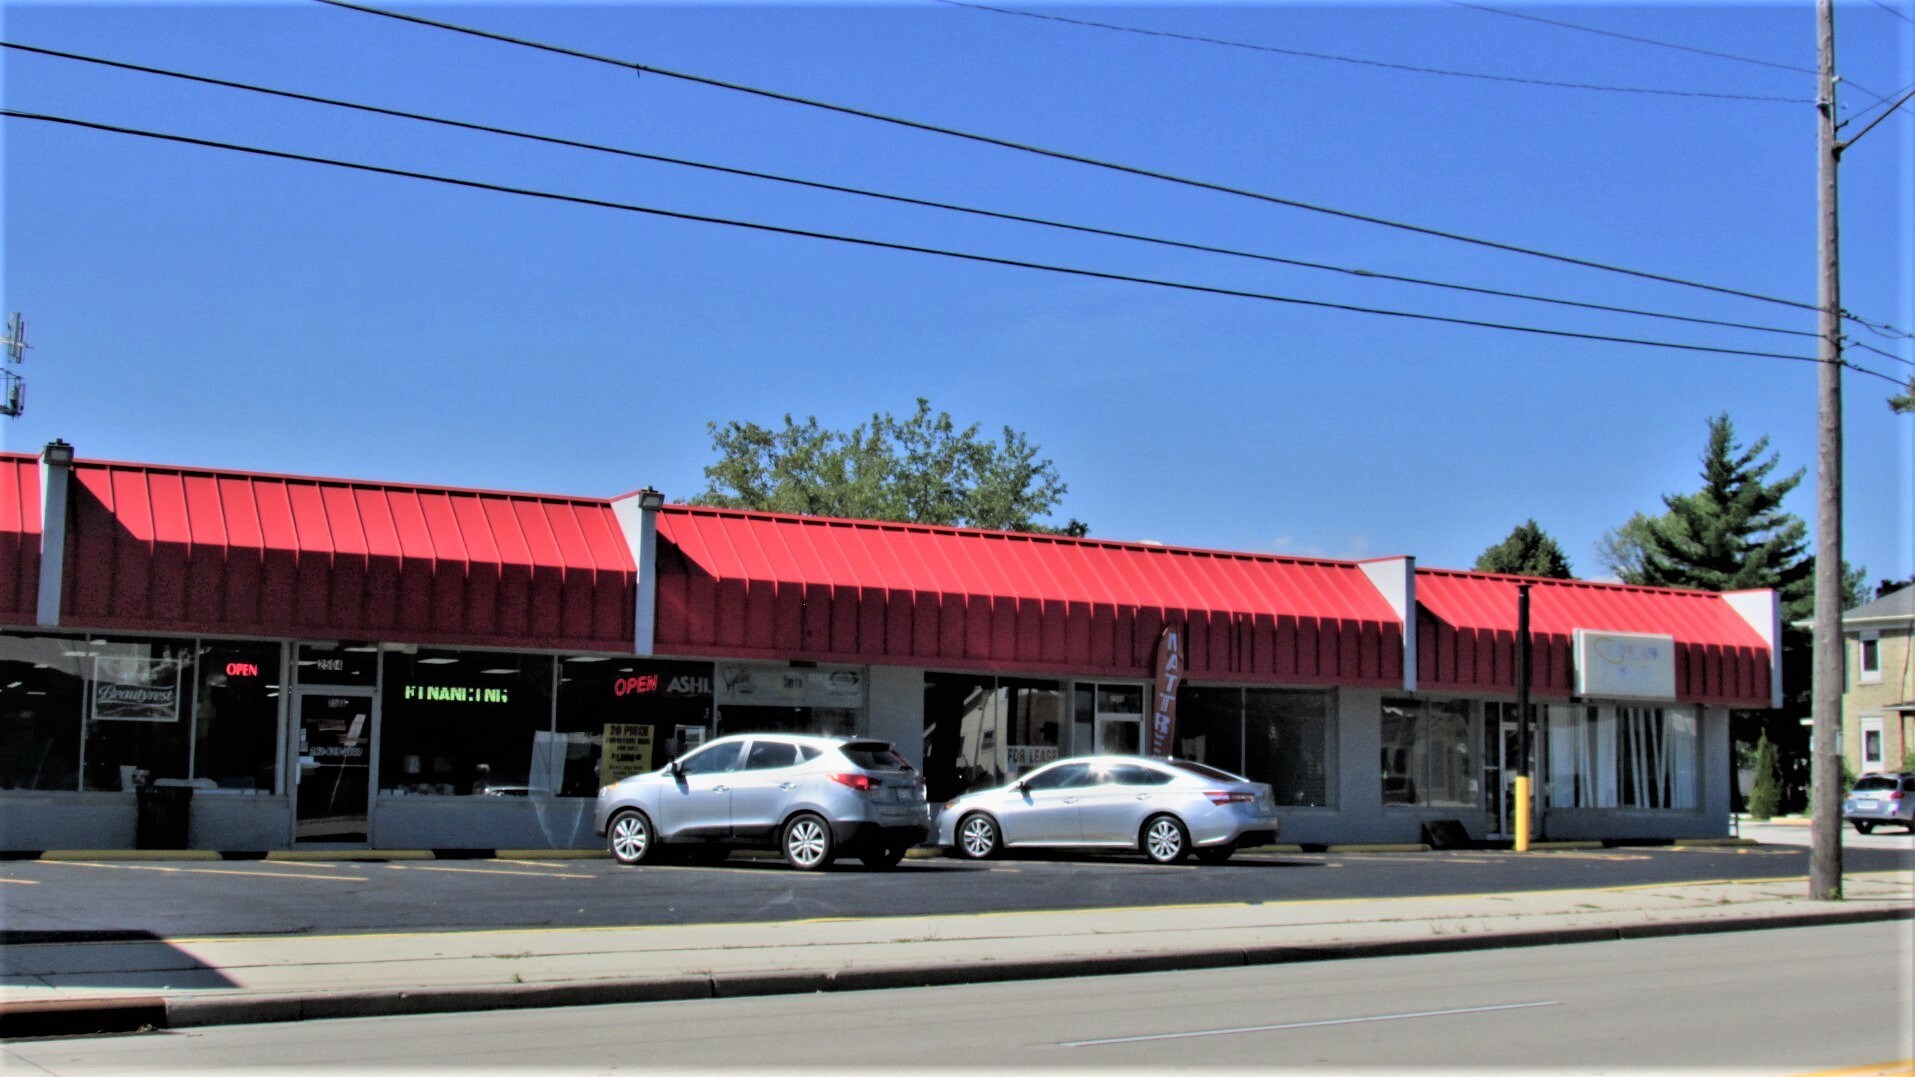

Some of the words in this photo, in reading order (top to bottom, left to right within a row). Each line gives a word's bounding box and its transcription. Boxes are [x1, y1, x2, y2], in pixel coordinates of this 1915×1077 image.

[226, 663, 258, 676] OPEN
[98, 683, 173, 703] Beautyrest
[614, 674, 658, 697] OPEN
[1007, 748, 1025, 763] FOR
[1029, 749, 1057, 763] LEASE
